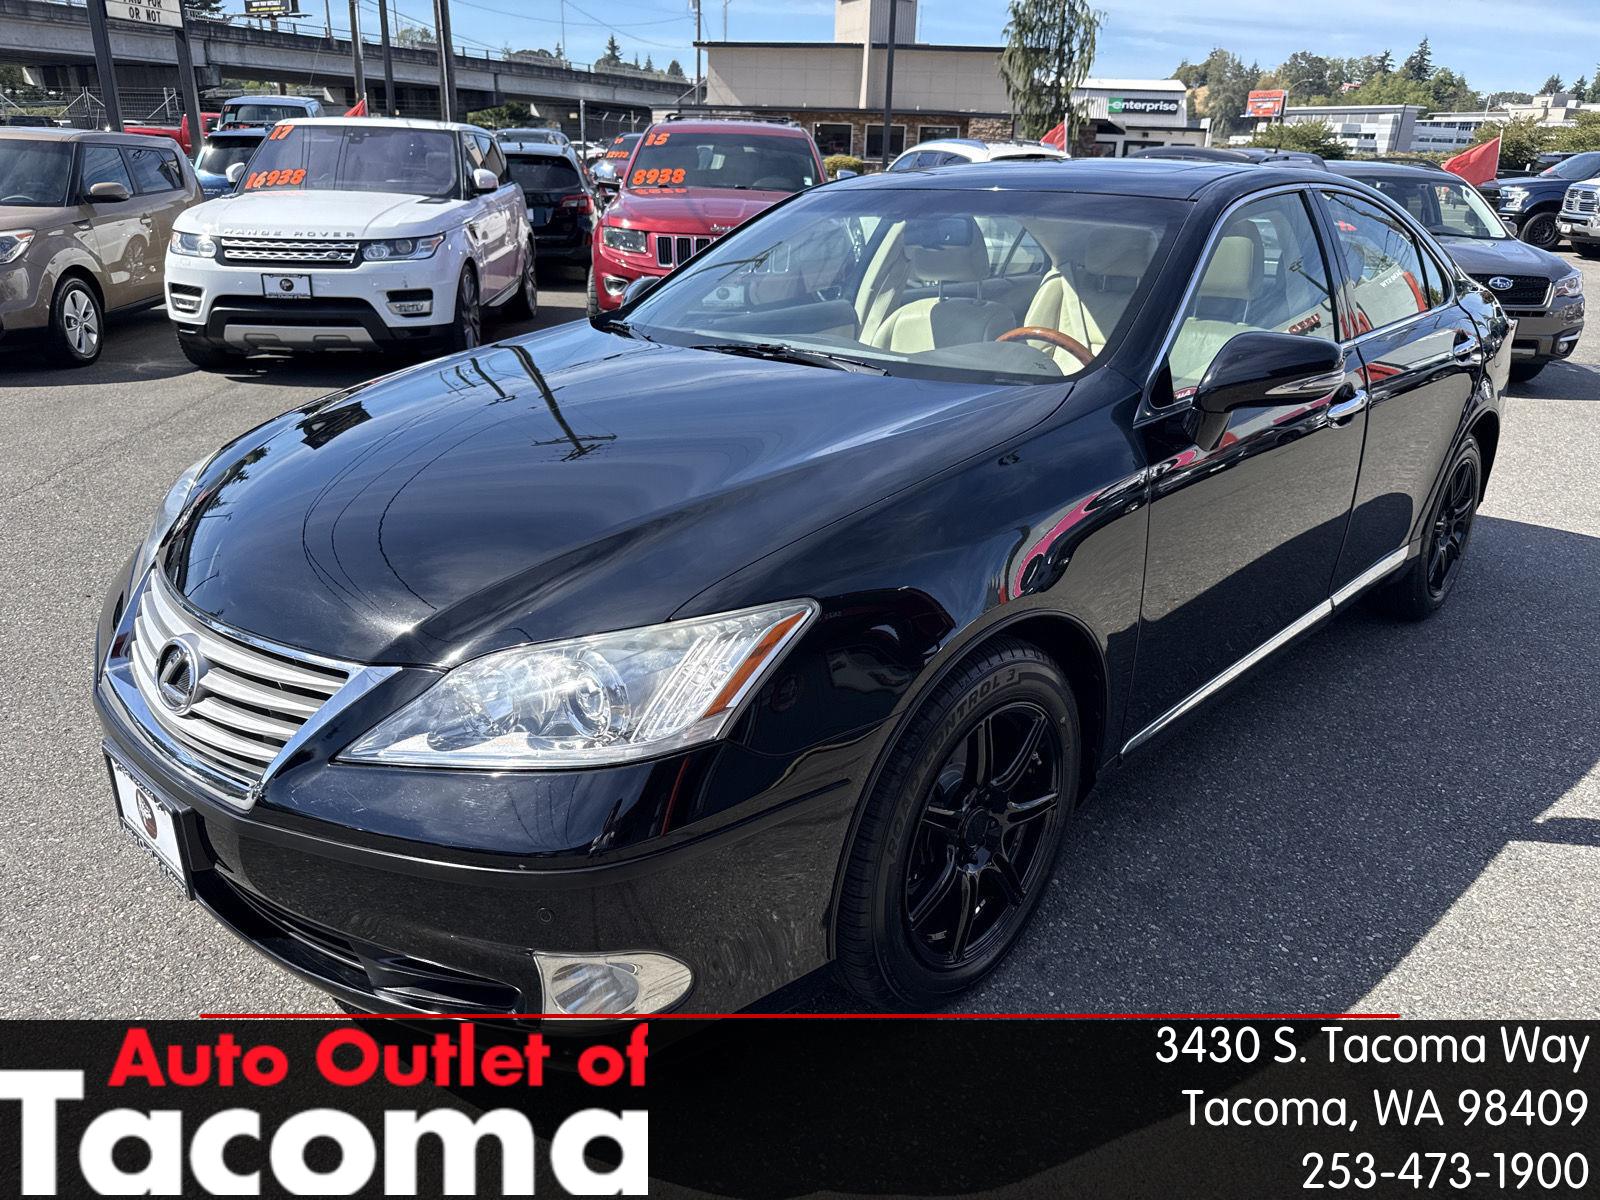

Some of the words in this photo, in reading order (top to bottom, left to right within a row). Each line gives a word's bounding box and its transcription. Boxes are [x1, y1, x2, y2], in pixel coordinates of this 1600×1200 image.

[129, 6, 141, 19] OR
[146, 9, 161, 22] NOT
[1108, 101, 1178, 112] enterprise
[268, 125, 295, 140] 17
[645, 132, 671, 146] 15
[244, 168, 307, 190] 16938
[632, 168, 687, 185] 8938
